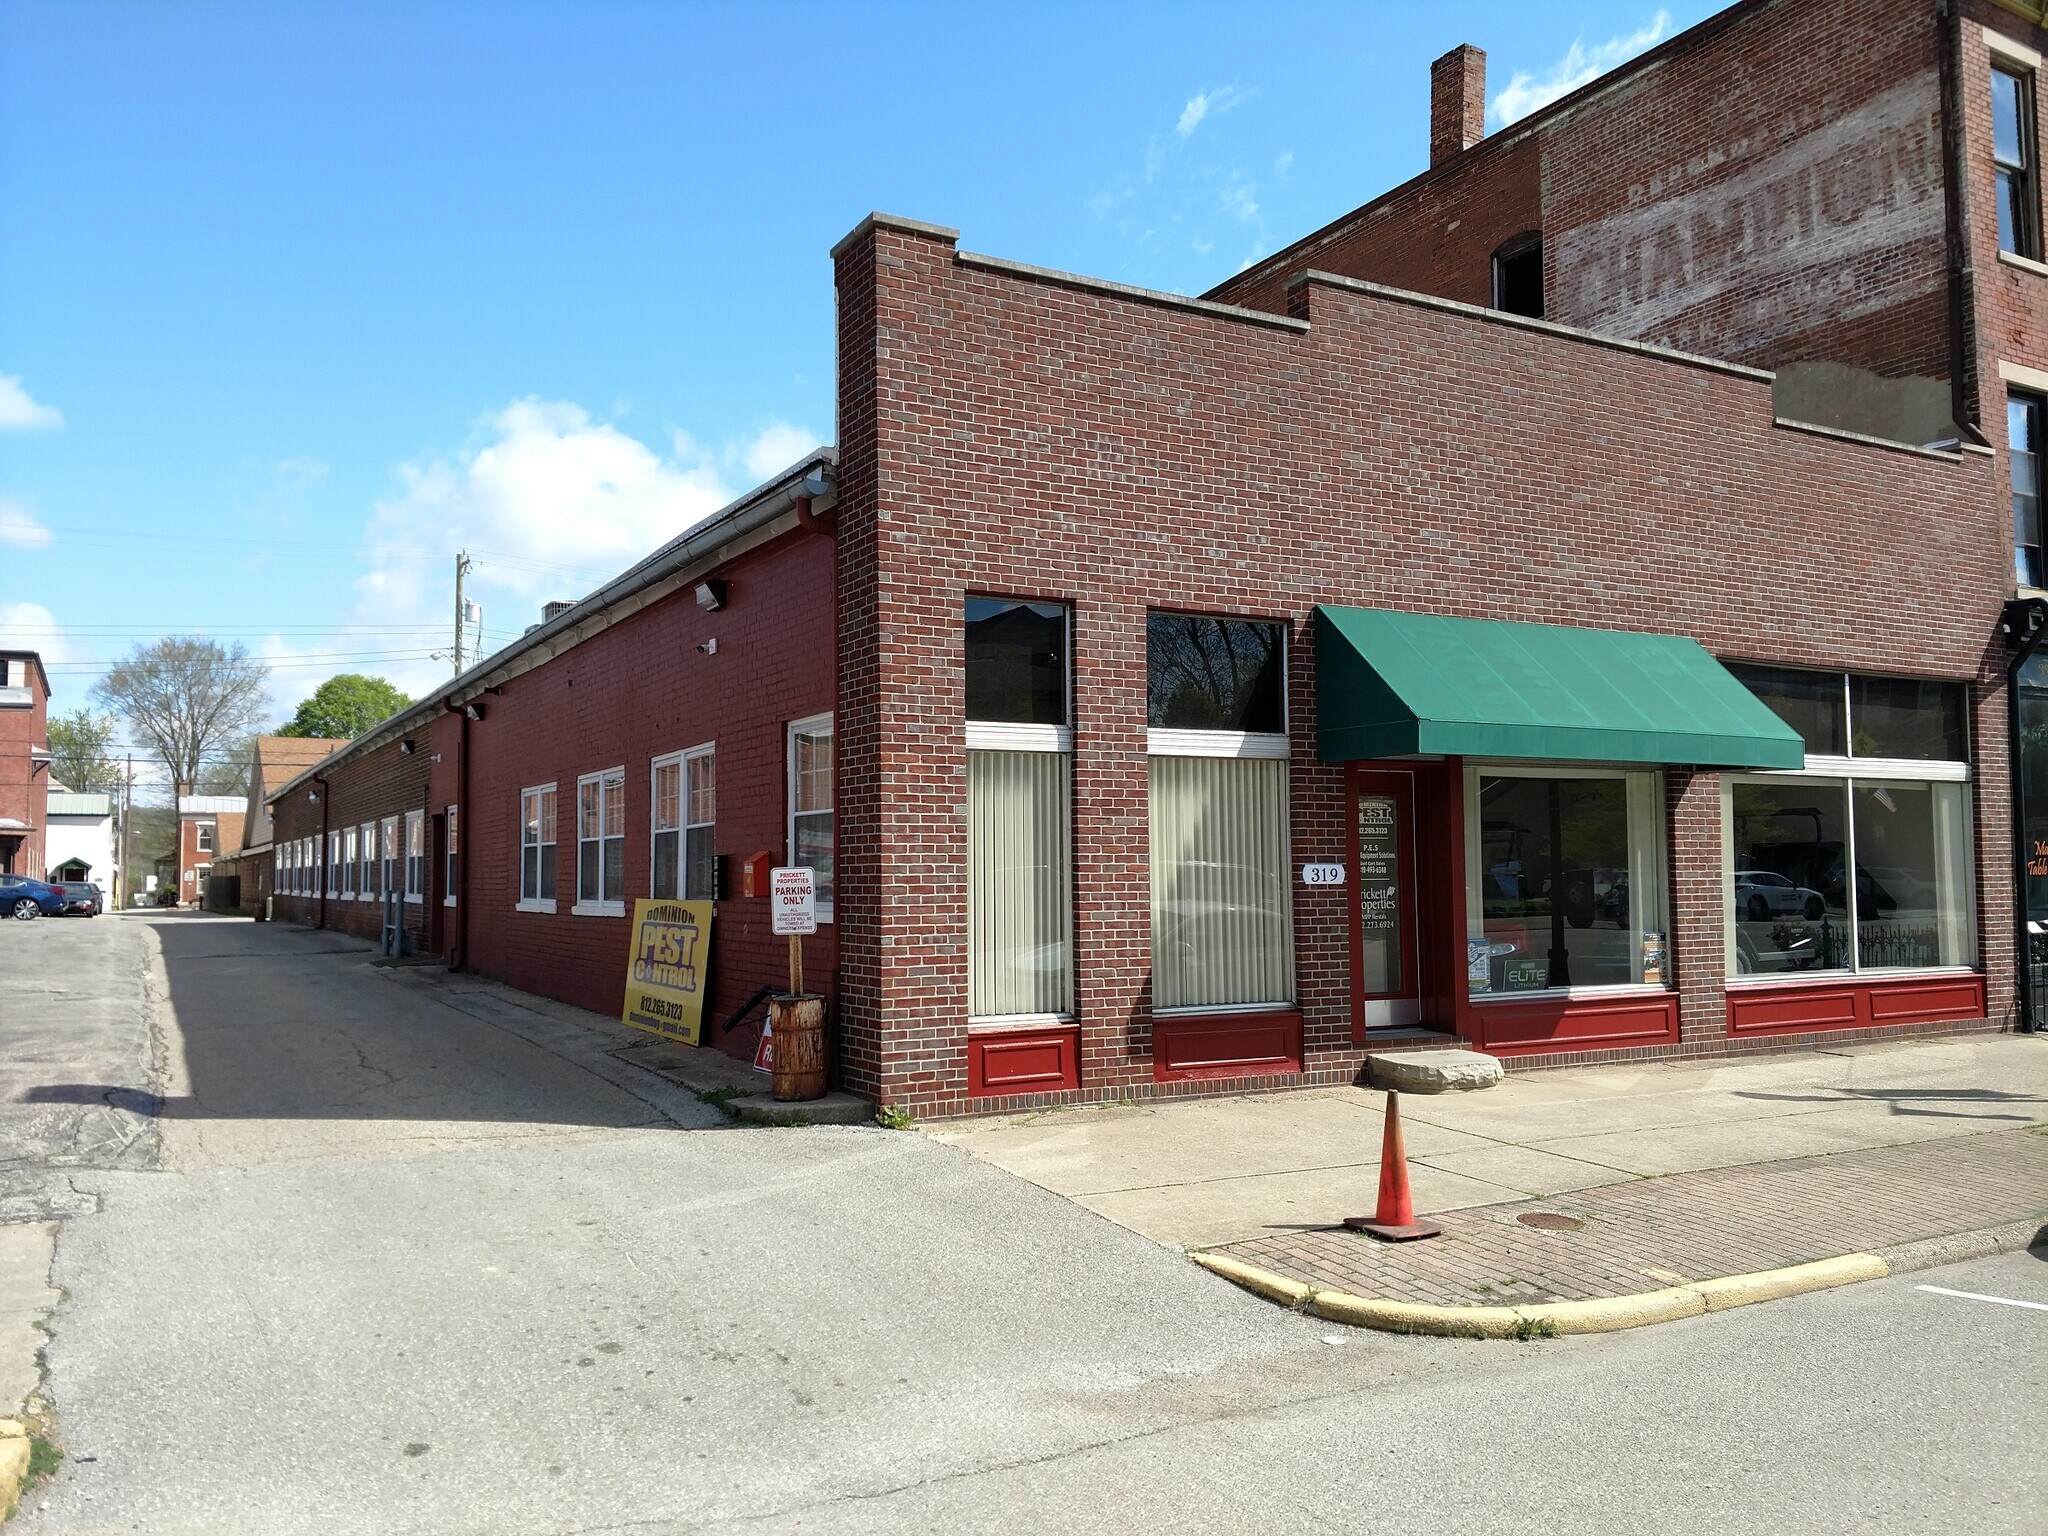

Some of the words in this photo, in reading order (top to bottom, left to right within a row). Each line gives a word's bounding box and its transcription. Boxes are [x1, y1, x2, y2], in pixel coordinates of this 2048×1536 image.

[1311, 867, 1338, 882] 319
[775, 886, 812, 895] PARKING
[1361, 887, 1387, 899] rickett
[783, 896, 805, 905] ONLY
[1361, 899, 1396, 913] operties
[647, 905, 696, 924] DOMINION
[1361, 921, 1395, 929] 2.273.6924
[640, 924, 698, 966] PEST
[635, 959, 695, 990] CONTROL
[640, 995, 683, 1021] 812.265.3123
